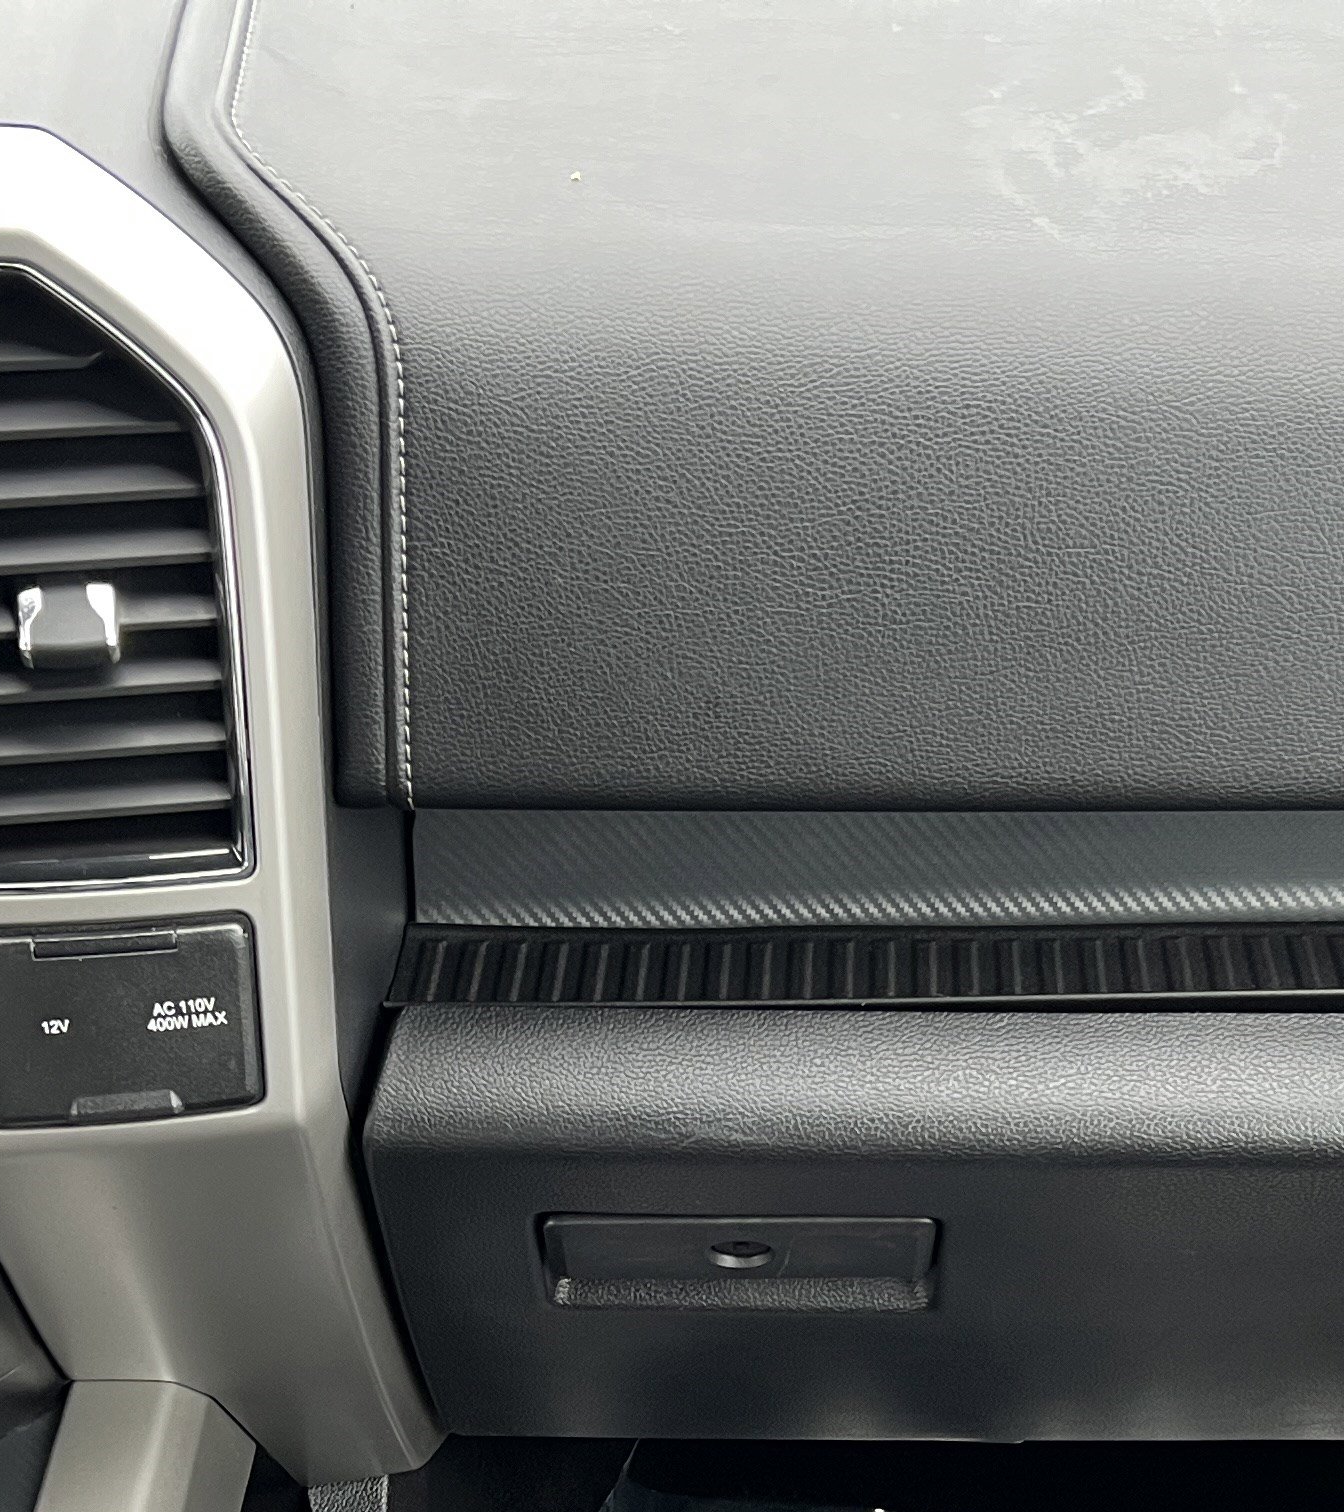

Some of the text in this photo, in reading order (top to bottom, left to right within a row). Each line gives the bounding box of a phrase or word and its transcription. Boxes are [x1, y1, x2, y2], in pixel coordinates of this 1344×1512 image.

[152, 997, 216, 1018] AC 110V
[41, 1019, 71, 1035] 12V
[147, 1010, 228, 1033] 400W MAX
